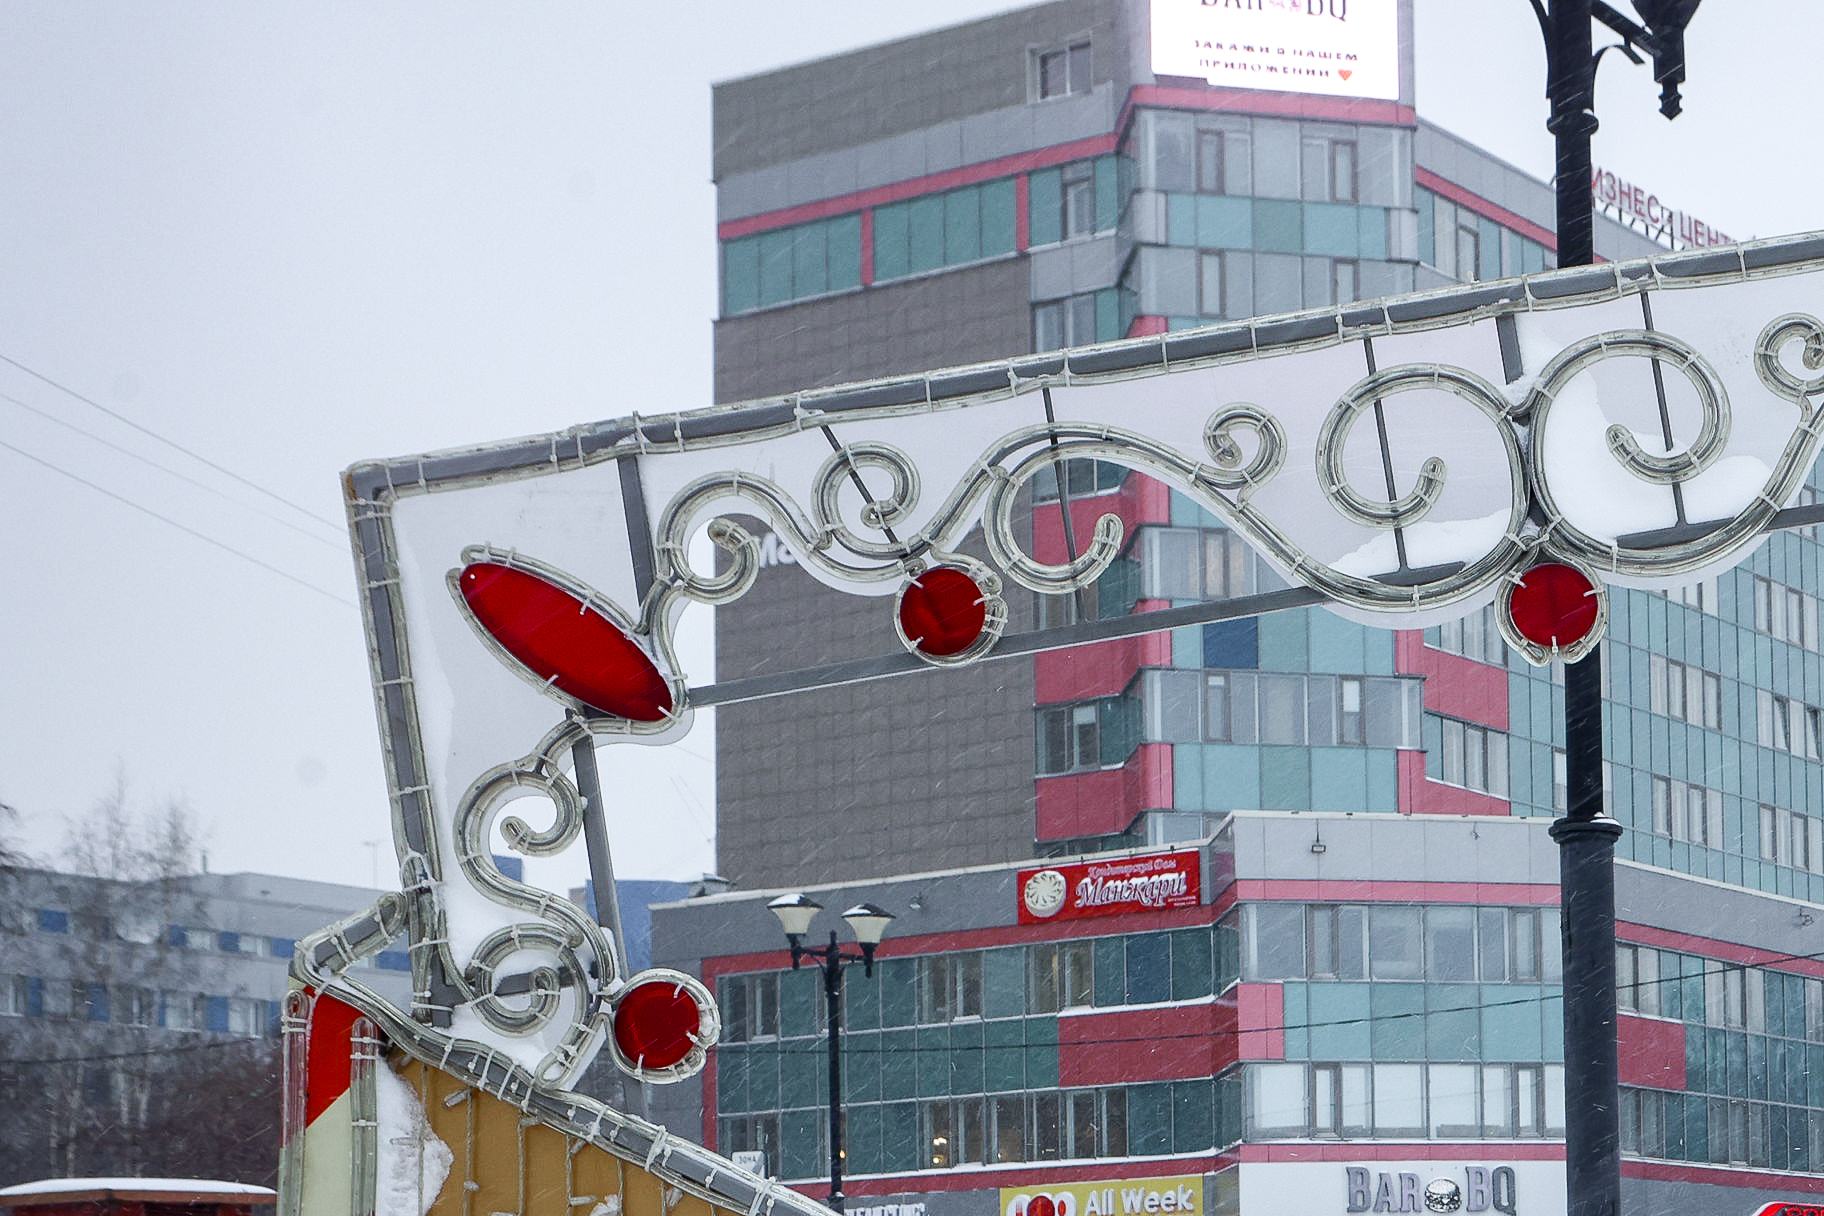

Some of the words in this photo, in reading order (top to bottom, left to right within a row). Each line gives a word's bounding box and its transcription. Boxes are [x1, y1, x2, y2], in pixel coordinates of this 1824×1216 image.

[1199, 58, 1330, 78] ПРИЛОЖЕНИИ
[1293, 48, 1358, 62] НАШЕМ
[1591, 163, 1660, 224] ИЗНЕС
[1075, 870, 1187, 908] Манжари
[1084, 1188, 1115, 1216] All
[1121, 1183, 1195, 1214] Week
[1346, 1166, 1422, 1214] BAR
[1465, 1165, 1517, 1216] BQ
